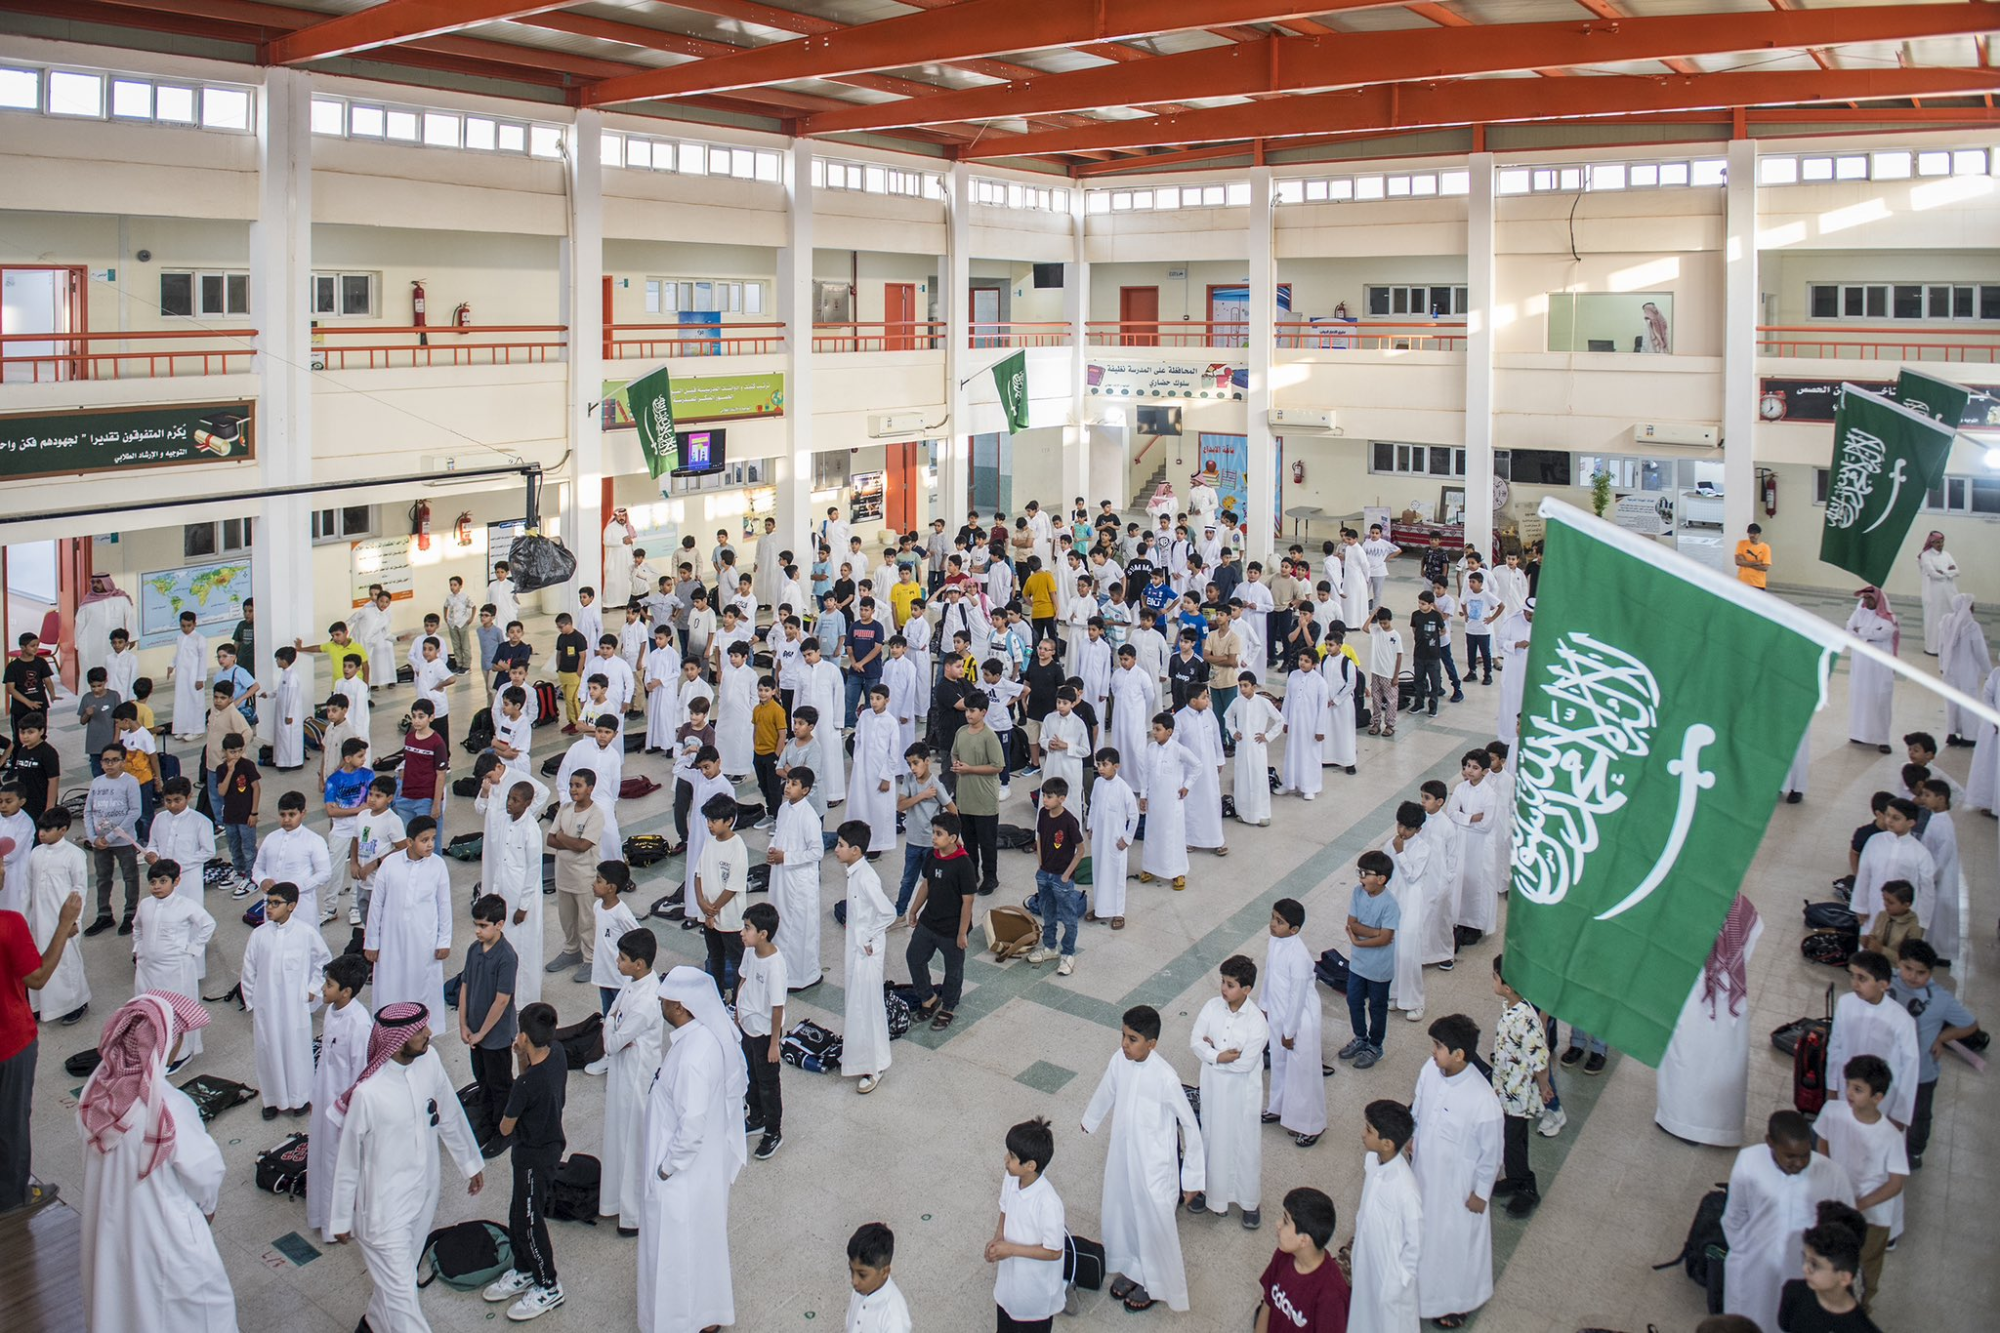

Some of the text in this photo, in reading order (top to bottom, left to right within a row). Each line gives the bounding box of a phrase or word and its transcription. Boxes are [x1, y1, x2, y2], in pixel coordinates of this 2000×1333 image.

[1128, 365, 1152, 375] المدرسة
[1153, 367, 1166, 376] على
[1168, 365, 1198, 375] المحافظة
[122, 429, 164, 443] المتفوقون
[18, 437, 38, 451] فكن
[40, 435, 78, 450] لجهودهم
[165, 448, 188, 458] التوجيه
